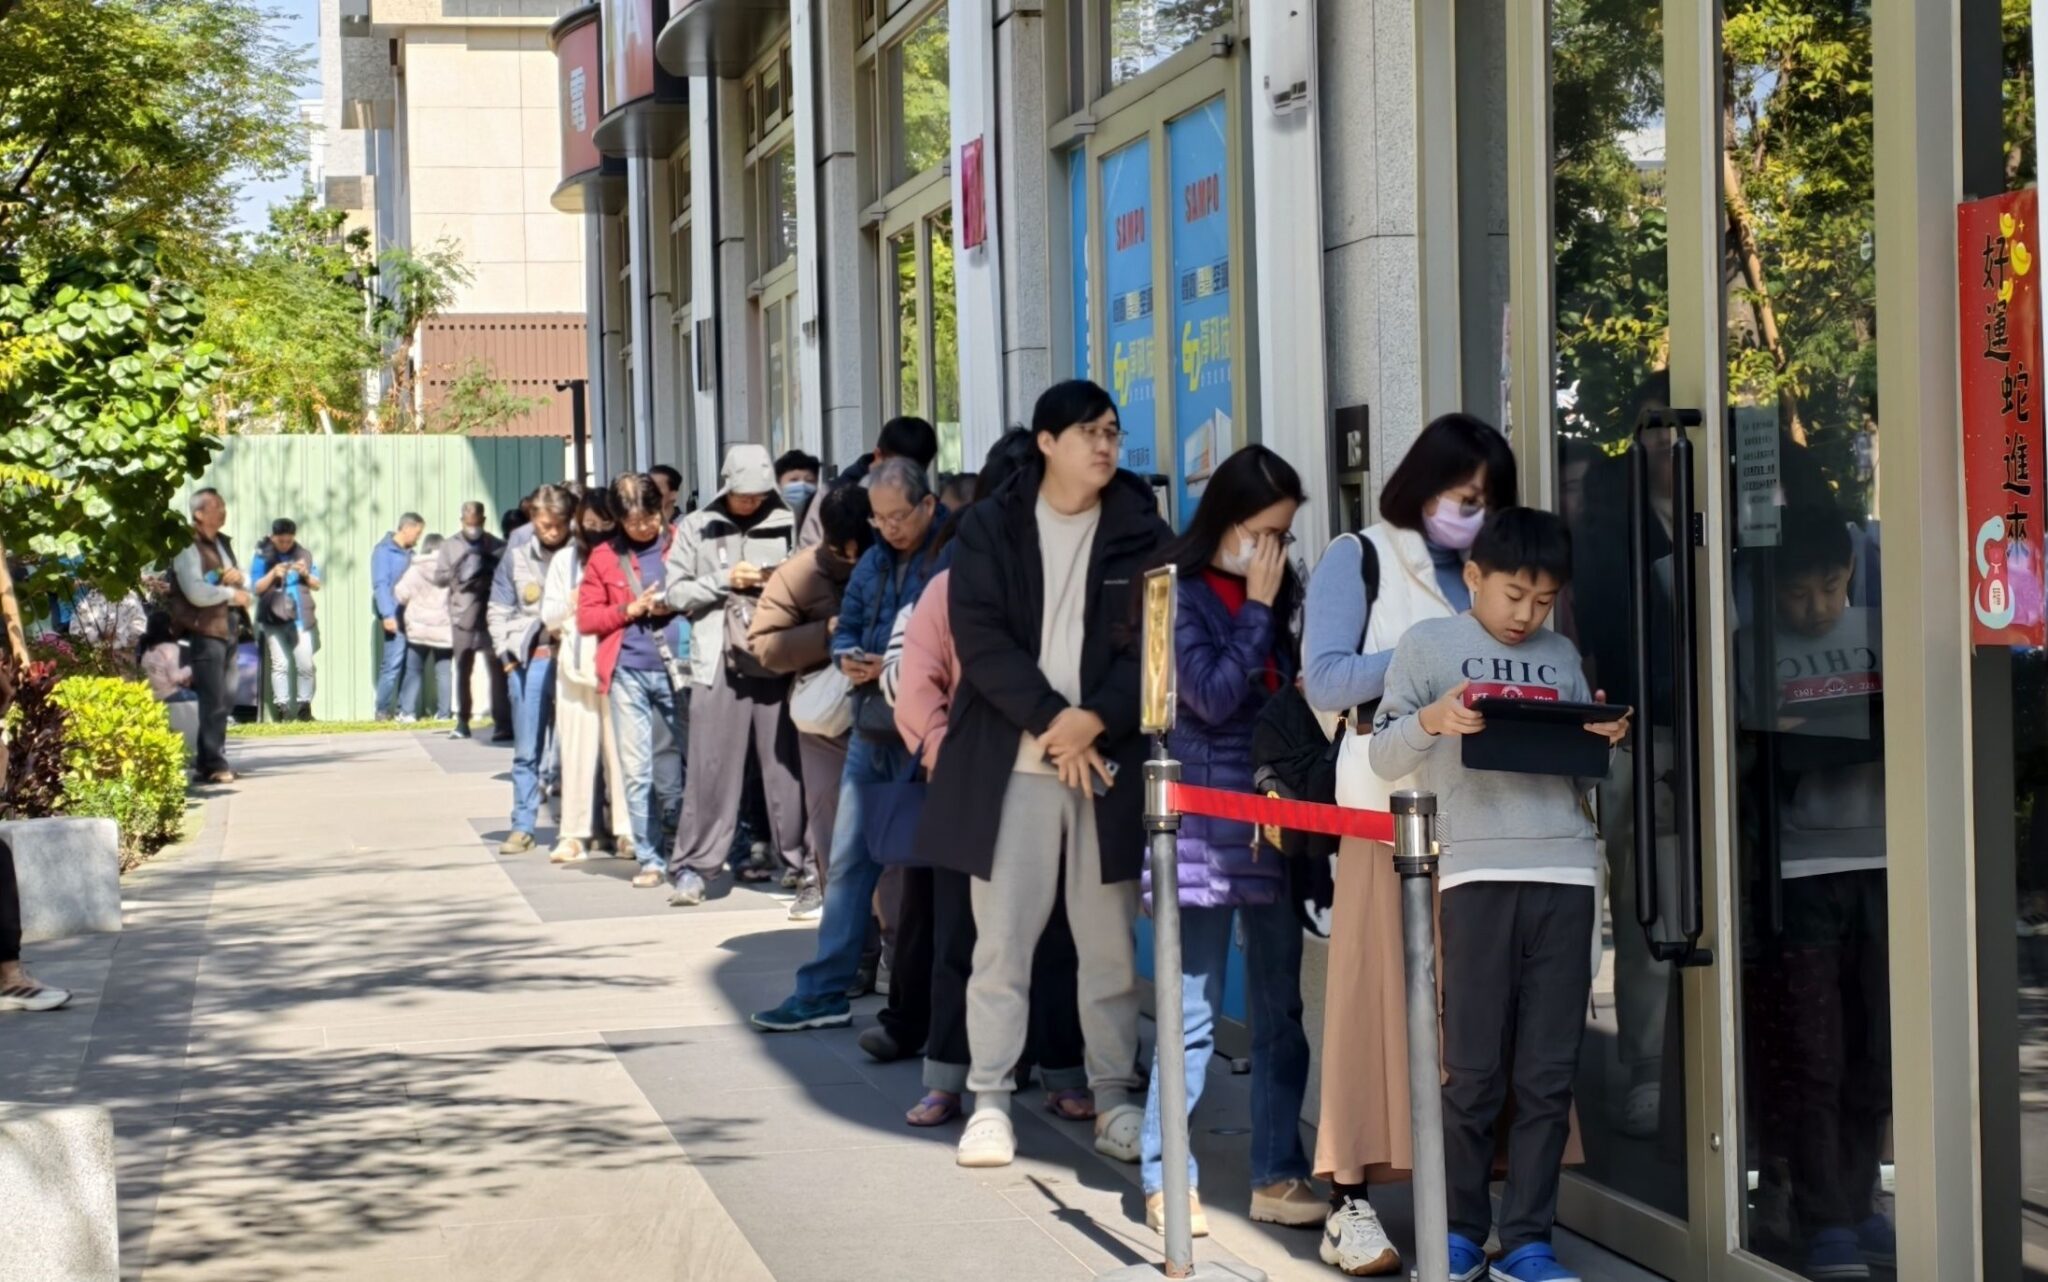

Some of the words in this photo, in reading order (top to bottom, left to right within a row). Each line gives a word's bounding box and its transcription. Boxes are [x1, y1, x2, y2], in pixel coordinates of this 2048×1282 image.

[1185, 172, 1219, 223] SAMPO
[1117, 206, 1145, 251] SAMPO
[1982, 234, 2031, 559] 好運蛇進來
[1461, 657, 1557, 685] CHIC
